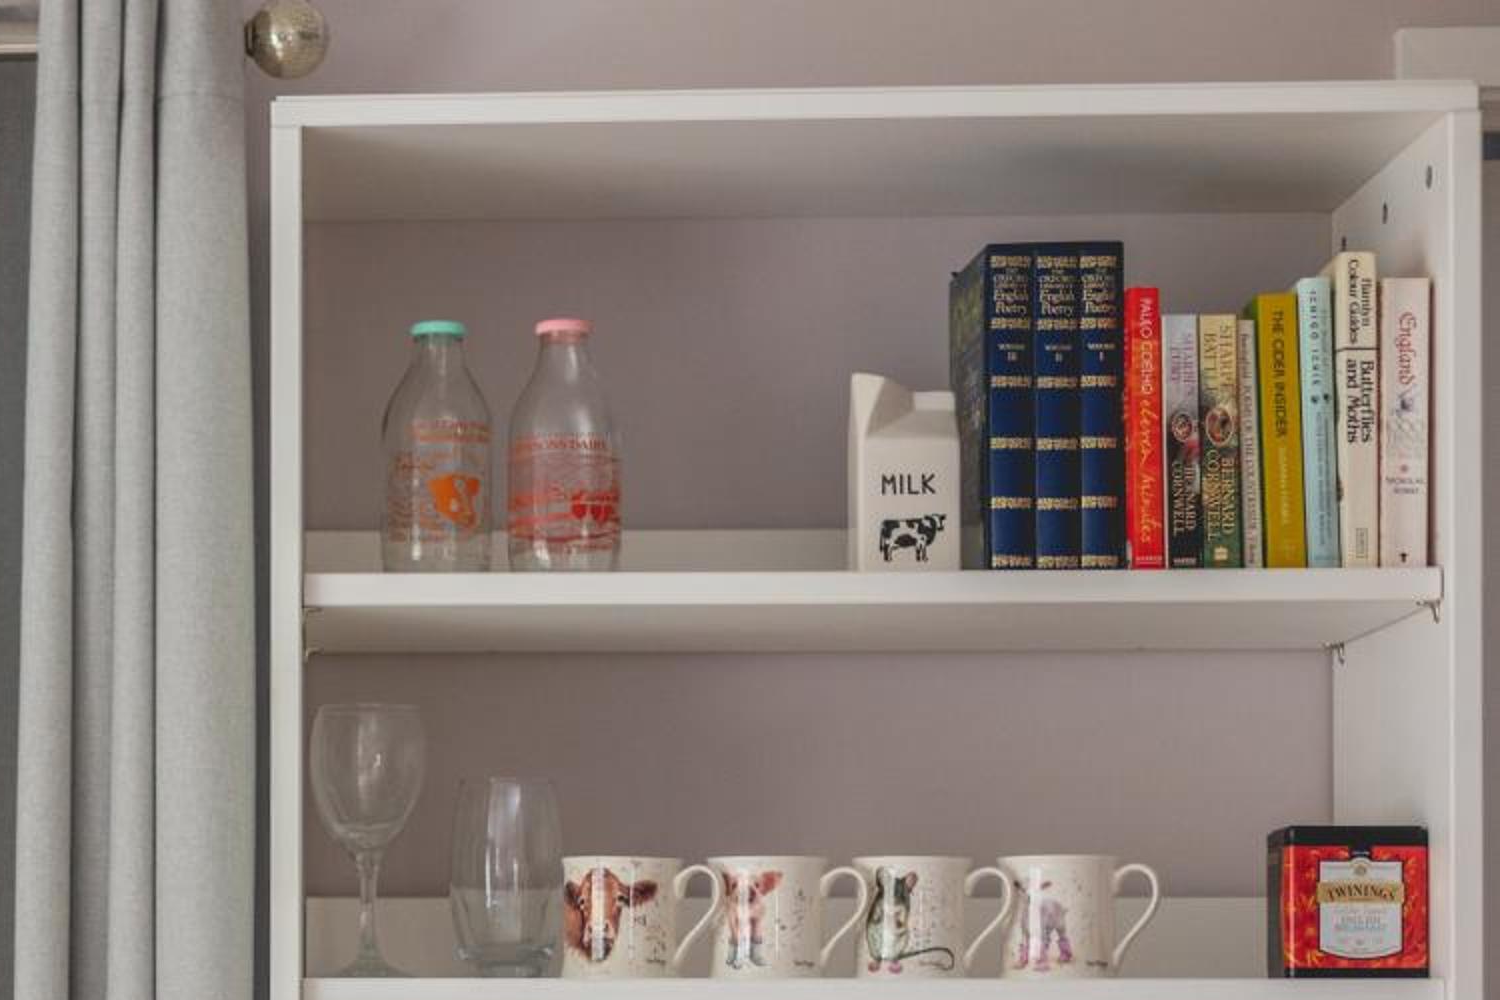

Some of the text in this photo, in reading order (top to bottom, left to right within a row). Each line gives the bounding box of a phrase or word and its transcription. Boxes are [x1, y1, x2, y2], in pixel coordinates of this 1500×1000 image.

[1271, 309, 1285, 336] THE
[1348, 259, 1362, 345] Colour Guides
[1360, 277, 1373, 327] Hamlyn
[1141, 340, 1154, 394] COELHO
[1272, 338, 1286, 378] CIDER
[1395, 311, 1418, 386] England
[1273, 381, 1288, 439] INSIDER
[1346, 359, 1361, 445] and Moths
[1360, 360, 1375, 444] Butterflies
[881, 473, 936, 494] MILK
[1171, 461, 1185, 537] CORNWELL
[1184, 466, 1197, 531] BERNARD
[1206, 448, 1221, 542] CORNWELL
[1221, 457, 1235, 535] BERNARD
[1325, 883, 1395, 901] TWININGS
